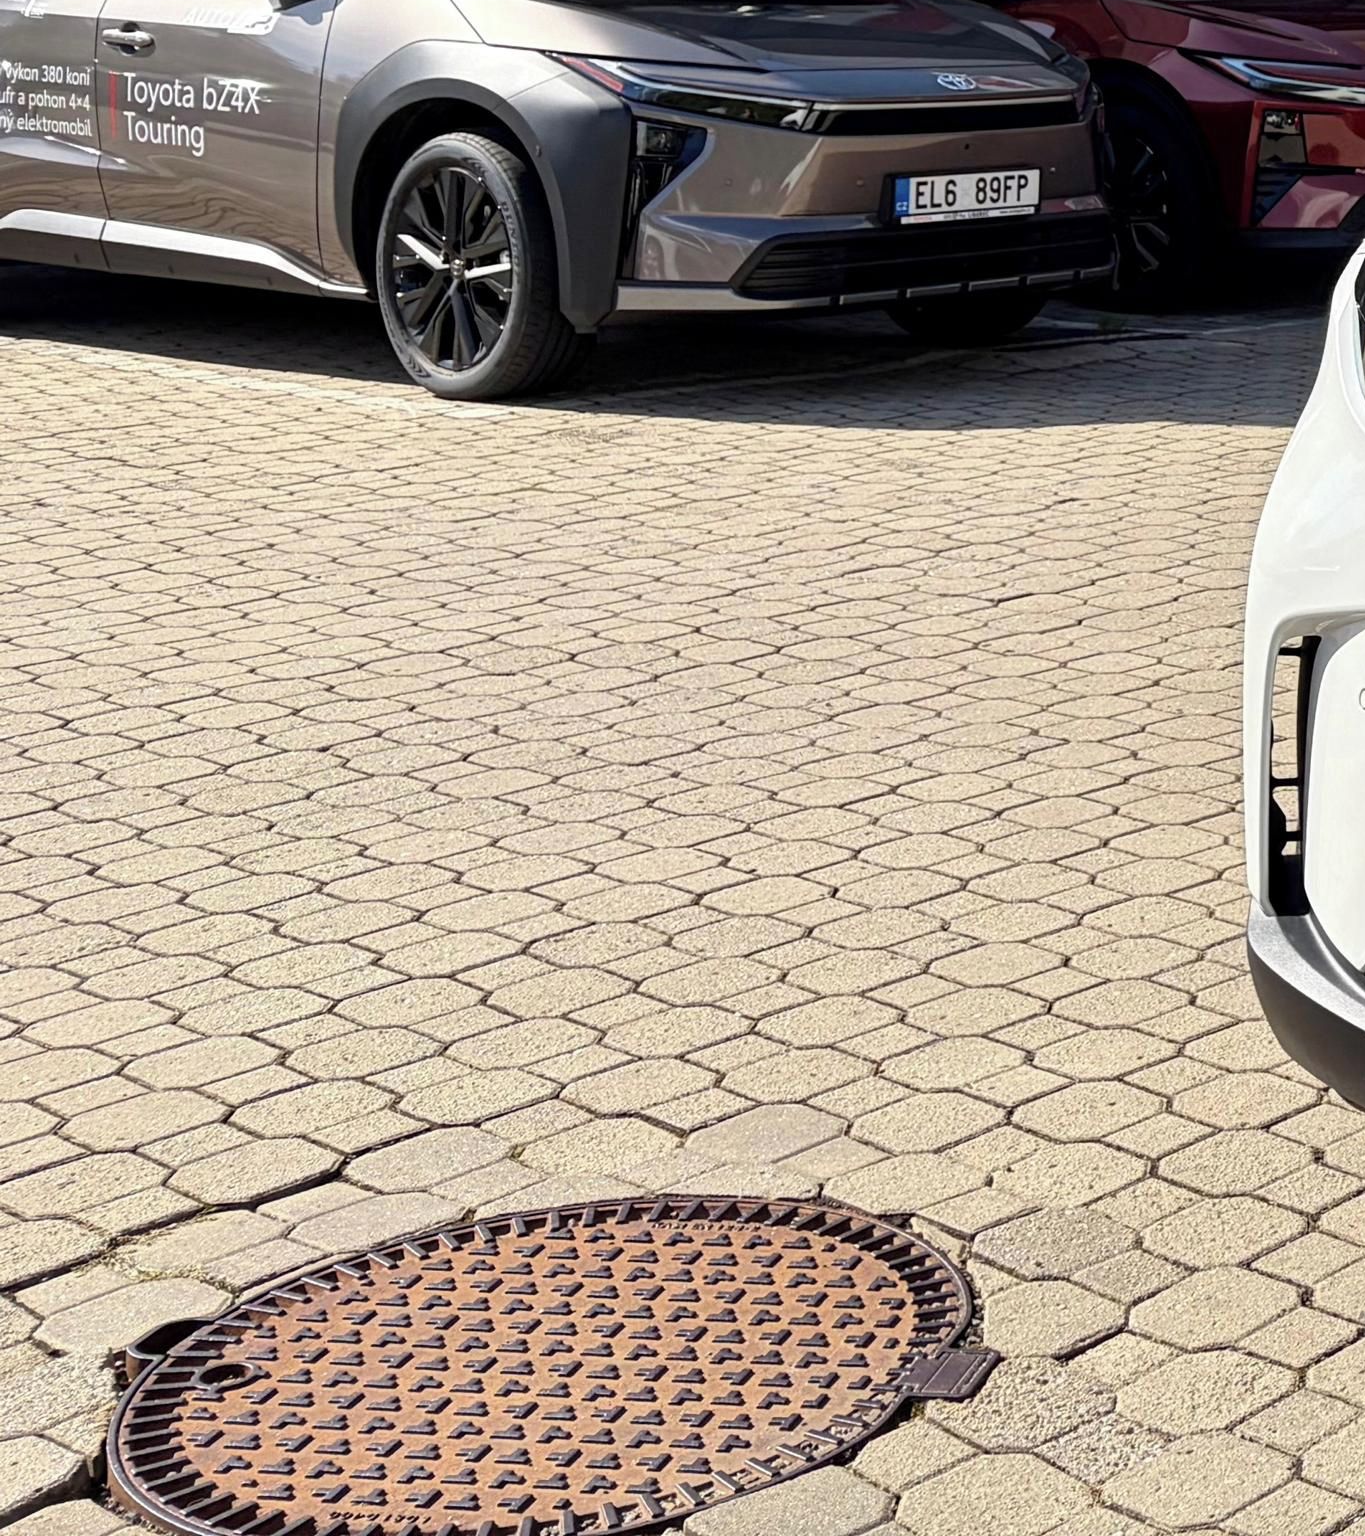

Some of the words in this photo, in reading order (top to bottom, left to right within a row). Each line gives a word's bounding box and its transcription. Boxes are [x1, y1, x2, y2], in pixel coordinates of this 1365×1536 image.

[41, 65, 64, 84] 380
[17, 91, 26, 105] a
[28, 89, 66, 110] pohon
[123, 72, 195, 112] Toyota
[202, 77, 262, 115] bZ4X
[17, 113, 93, 137] elektromobil
[123, 111, 206, 157] Touring
[915, 179, 957, 210] EL6
[975, 174, 1029, 205] 89FP
